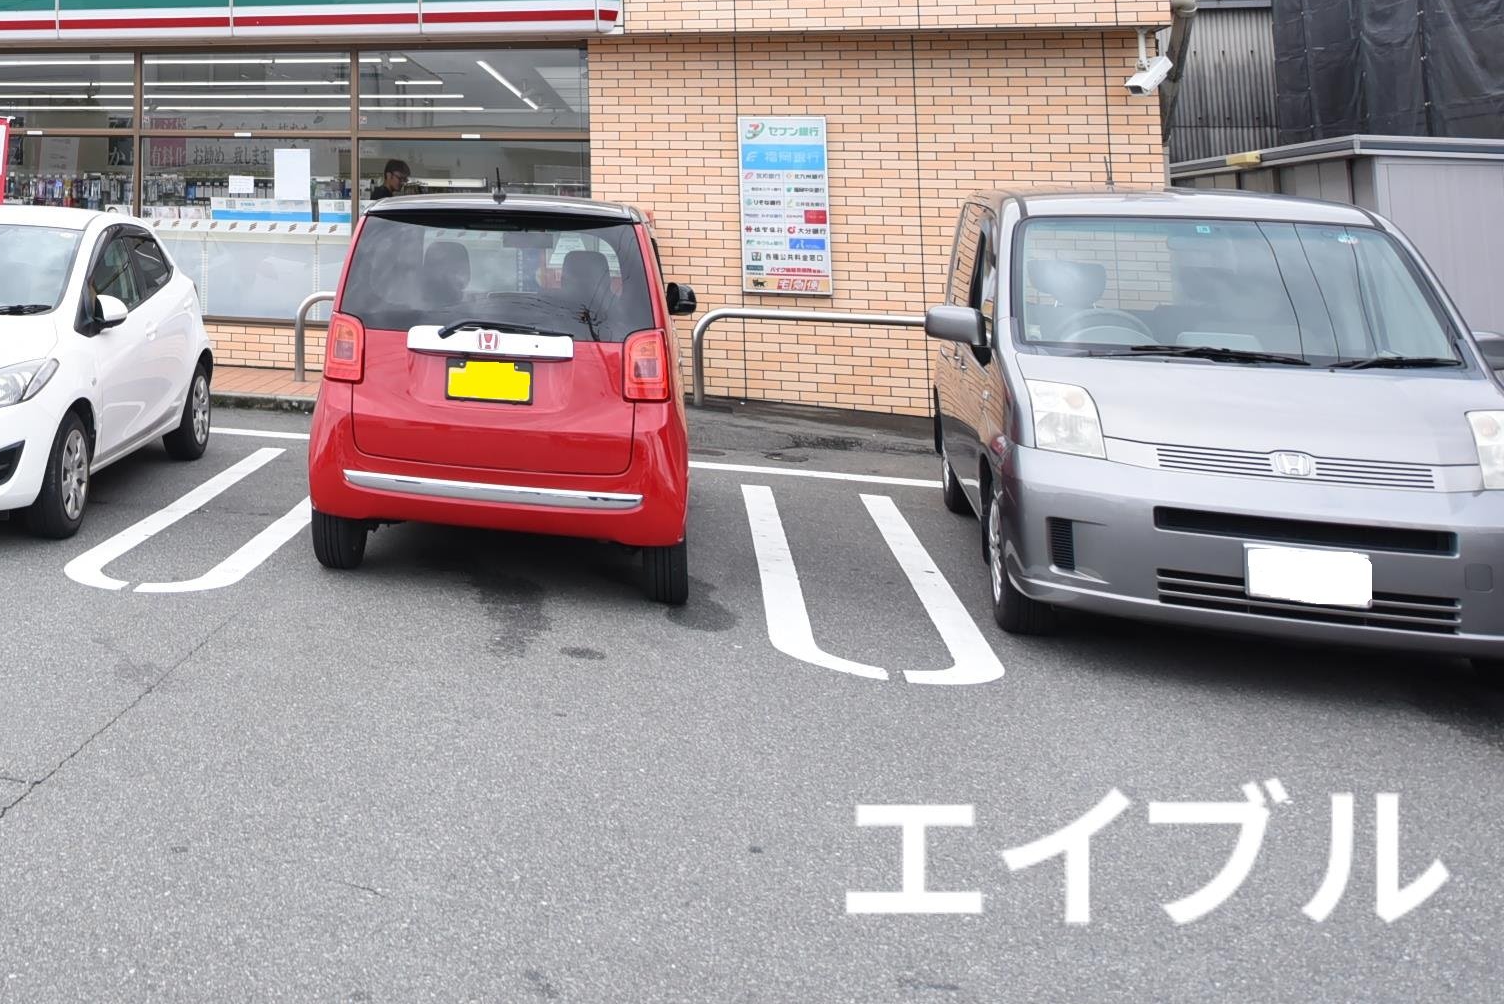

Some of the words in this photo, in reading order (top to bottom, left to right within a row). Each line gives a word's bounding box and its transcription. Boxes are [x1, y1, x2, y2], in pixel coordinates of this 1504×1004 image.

[768, 126, 819, 137] セブン銀行
[765, 150, 821, 165] 福岡銀行
[798, 227, 827, 235] 大分銀行
[765, 253, 824, 262] 各種公共料金窓口
